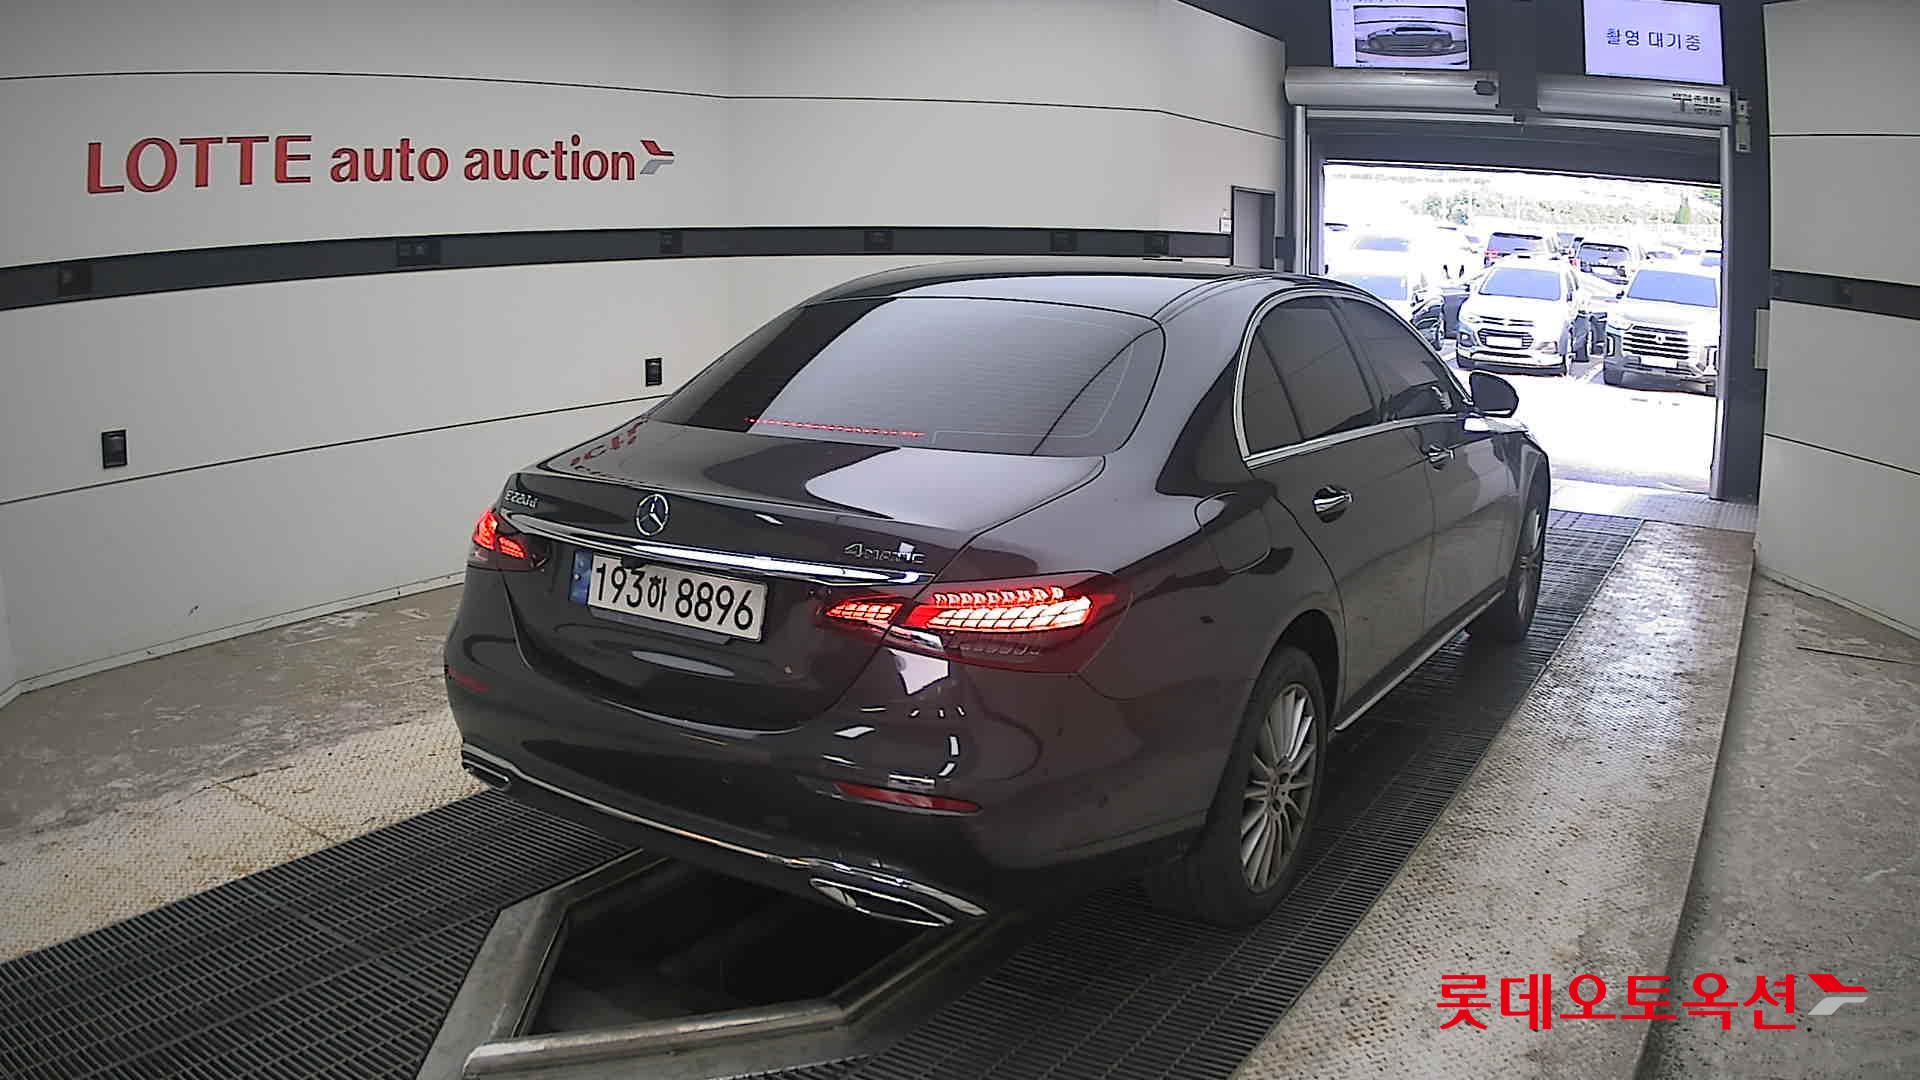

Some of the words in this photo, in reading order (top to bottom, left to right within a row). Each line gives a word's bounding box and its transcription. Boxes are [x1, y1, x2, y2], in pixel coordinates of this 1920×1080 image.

[87, 135, 313, 194] LOTTE
[329, 138, 449, 183] auto
[463, 134, 636, 183] auction
[675, 578, 754, 631] 8896
